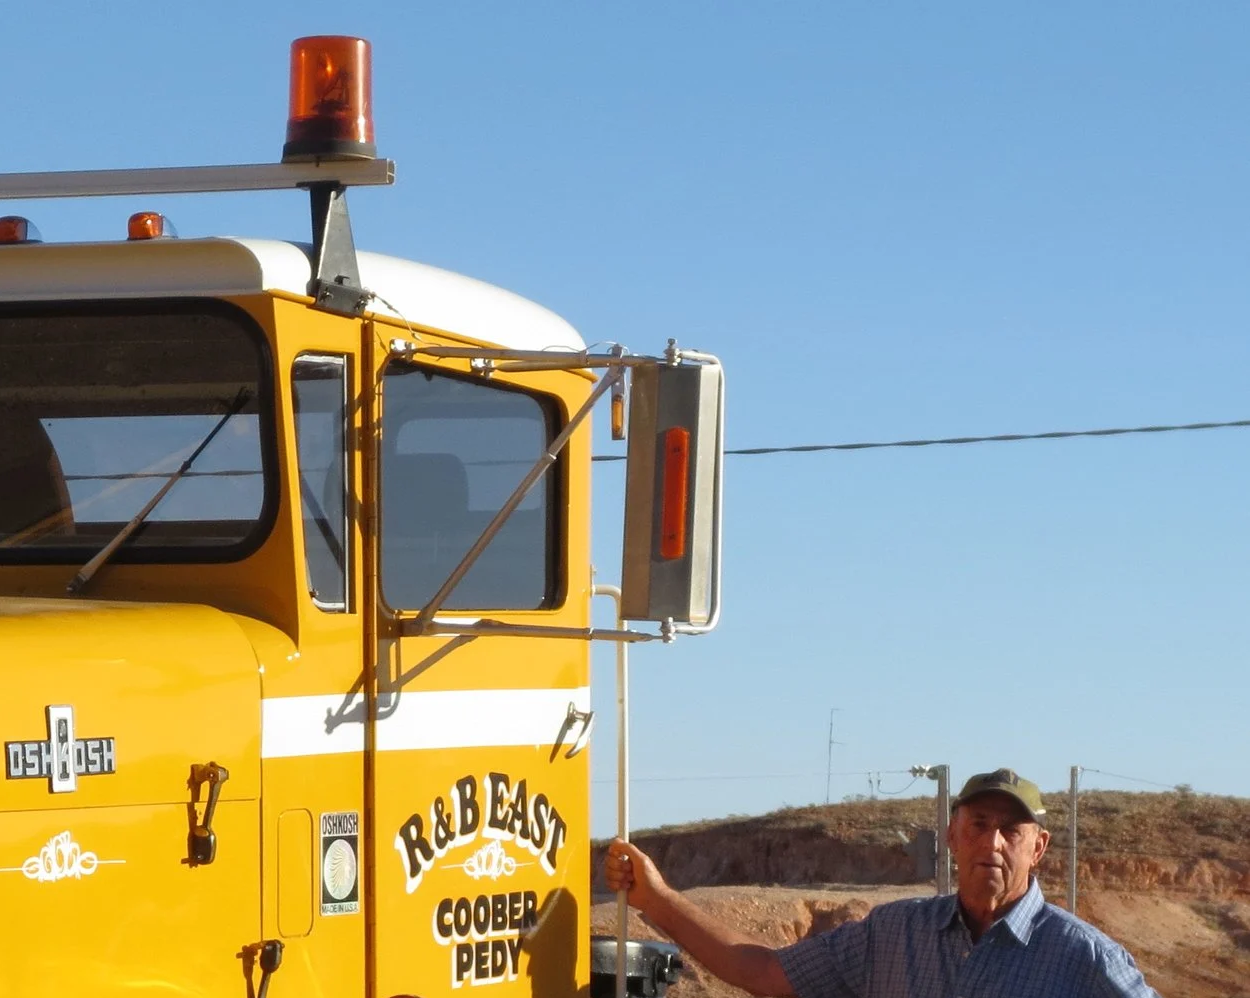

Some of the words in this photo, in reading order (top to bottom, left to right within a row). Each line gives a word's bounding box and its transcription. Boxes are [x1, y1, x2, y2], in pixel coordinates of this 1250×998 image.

[8, 738, 115, 779] OSHKOSH
[322, 813, 358, 835] OSHKOSH
[487, 771, 568, 872] EAST
[435, 890, 539, 939] COOBER
[455, 938, 524, 983] PEDY
